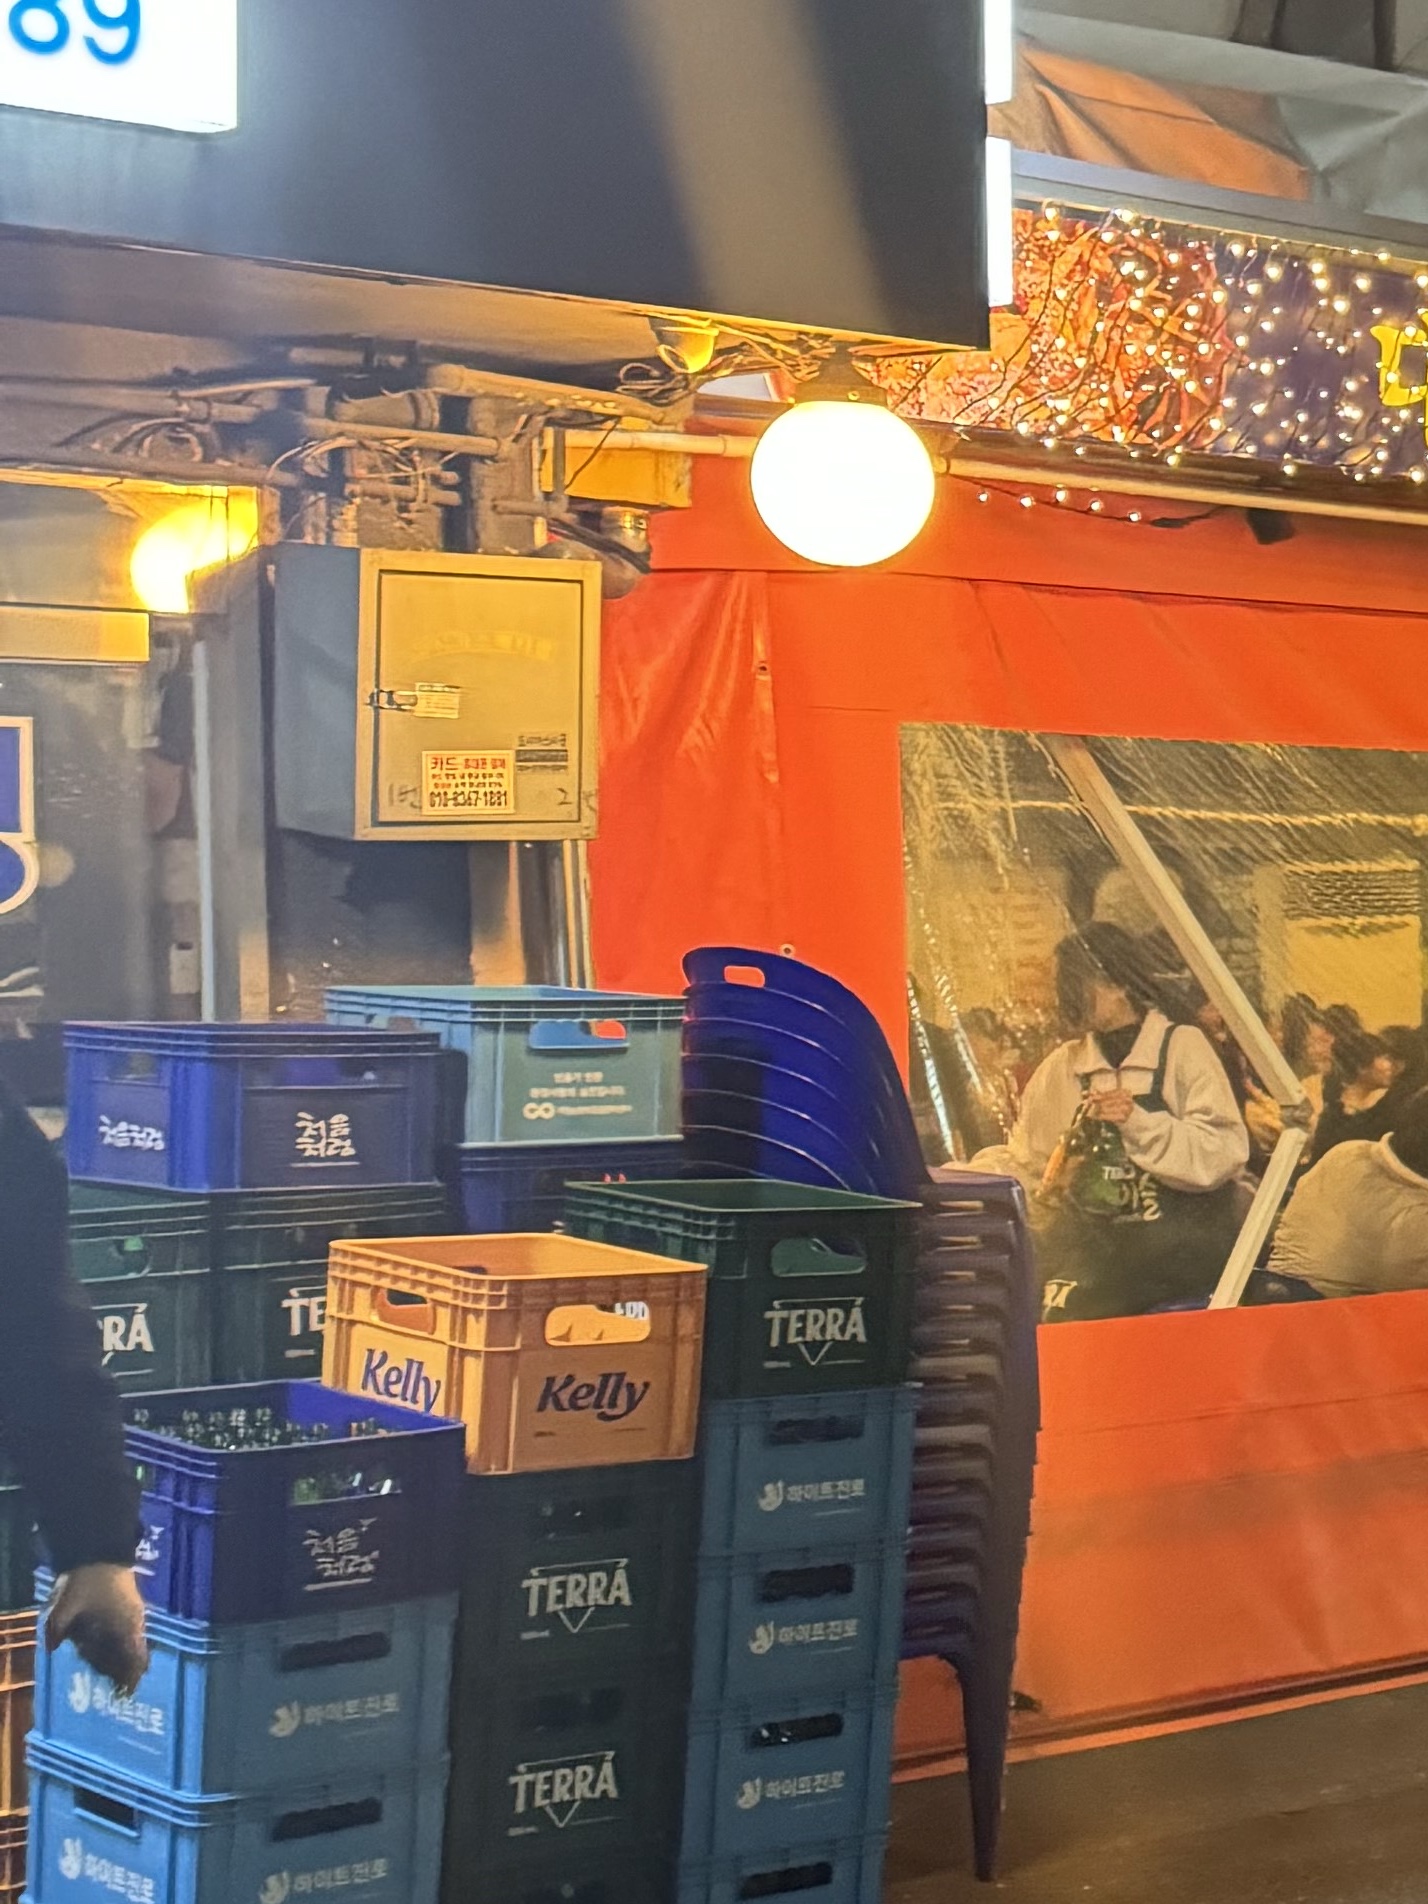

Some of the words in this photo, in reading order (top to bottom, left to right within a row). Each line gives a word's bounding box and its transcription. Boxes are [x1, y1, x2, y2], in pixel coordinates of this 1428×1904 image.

[763, 1299, 868, 1350] TERRA
[361, 1347, 442, 1414] Kelly
[537, 1371, 651, 1422] Kelly
[787, 1478, 866, 1502] 하이트진로
[520, 1567, 632, 1617] TERRA
[777, 1619, 859, 1644] 하이트진로
[508, 1760, 619, 1815] TERRA
[293, 1858, 390, 1895] 하이트진로
